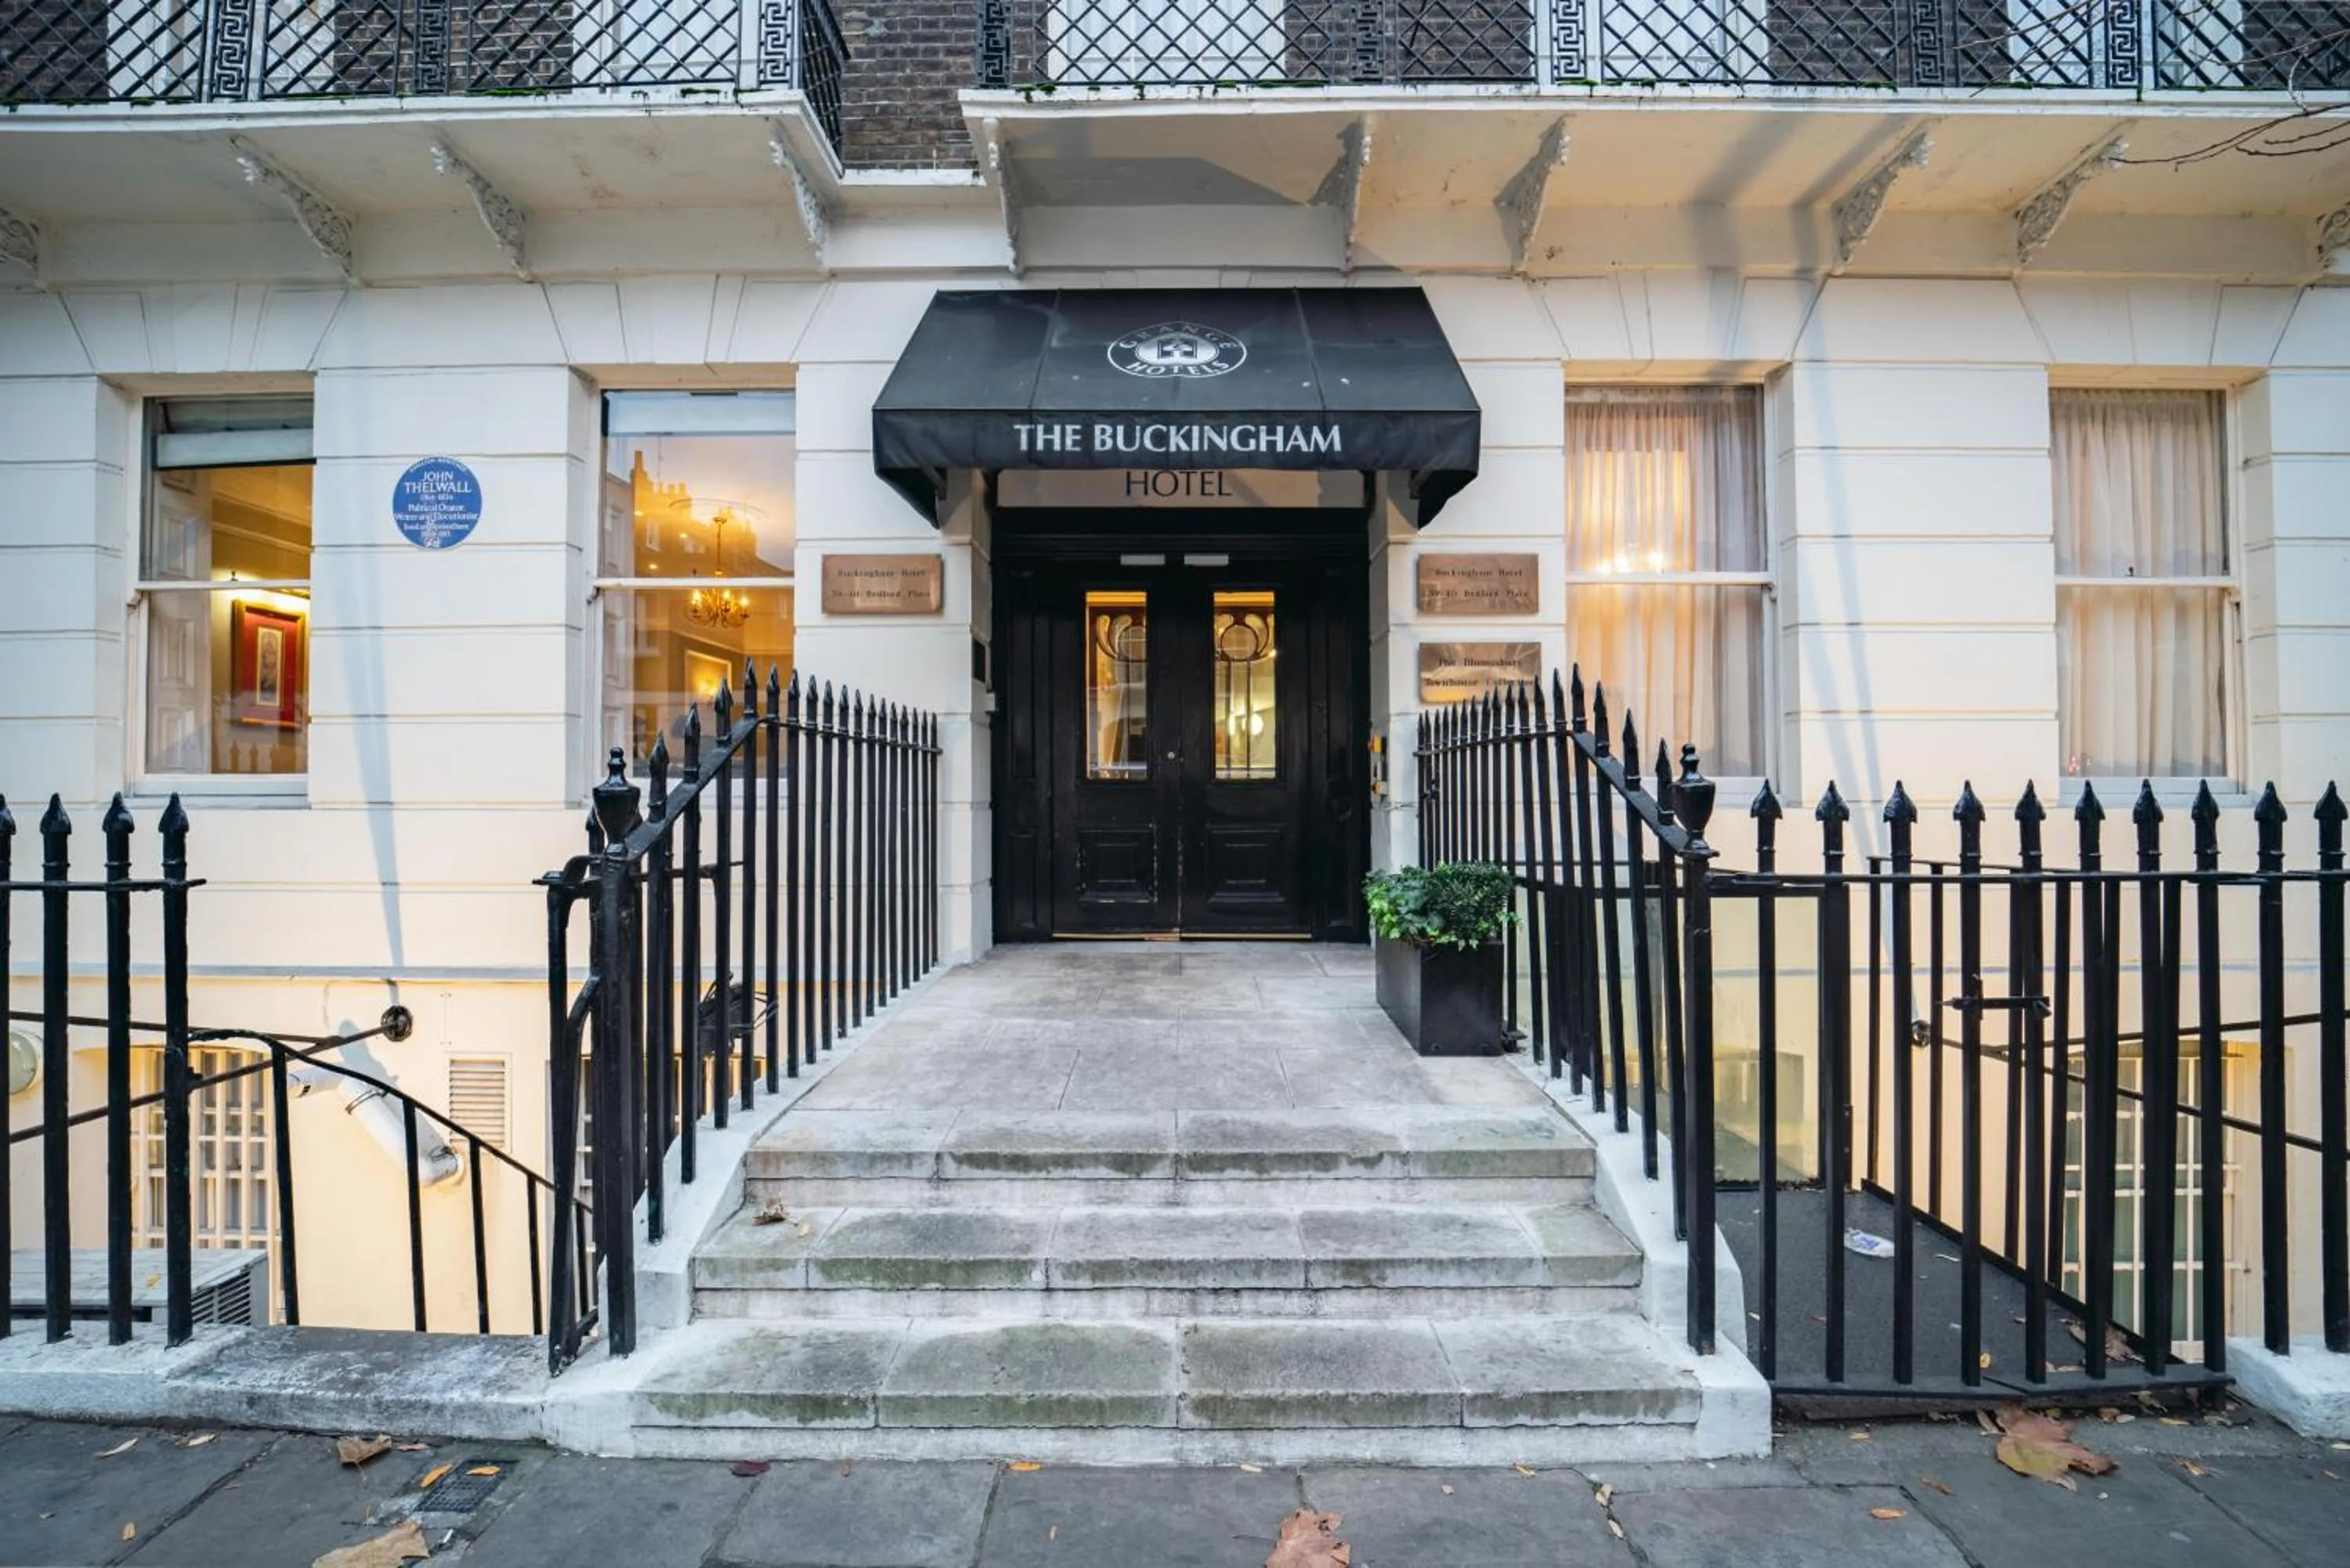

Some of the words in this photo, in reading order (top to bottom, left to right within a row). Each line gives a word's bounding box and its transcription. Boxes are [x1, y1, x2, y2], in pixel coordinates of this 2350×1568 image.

[1119, 325, 1238, 349] GRANGE
[1125, 360, 1229, 375] HOTELS
[1014, 424, 1082, 452] THE
[1094, 424, 1342, 452] BUCKINGHAM
[421, 470, 454, 482] JOHN
[1126, 471, 1233, 497] HOTEL
[403, 481, 472, 493] THELWALL
